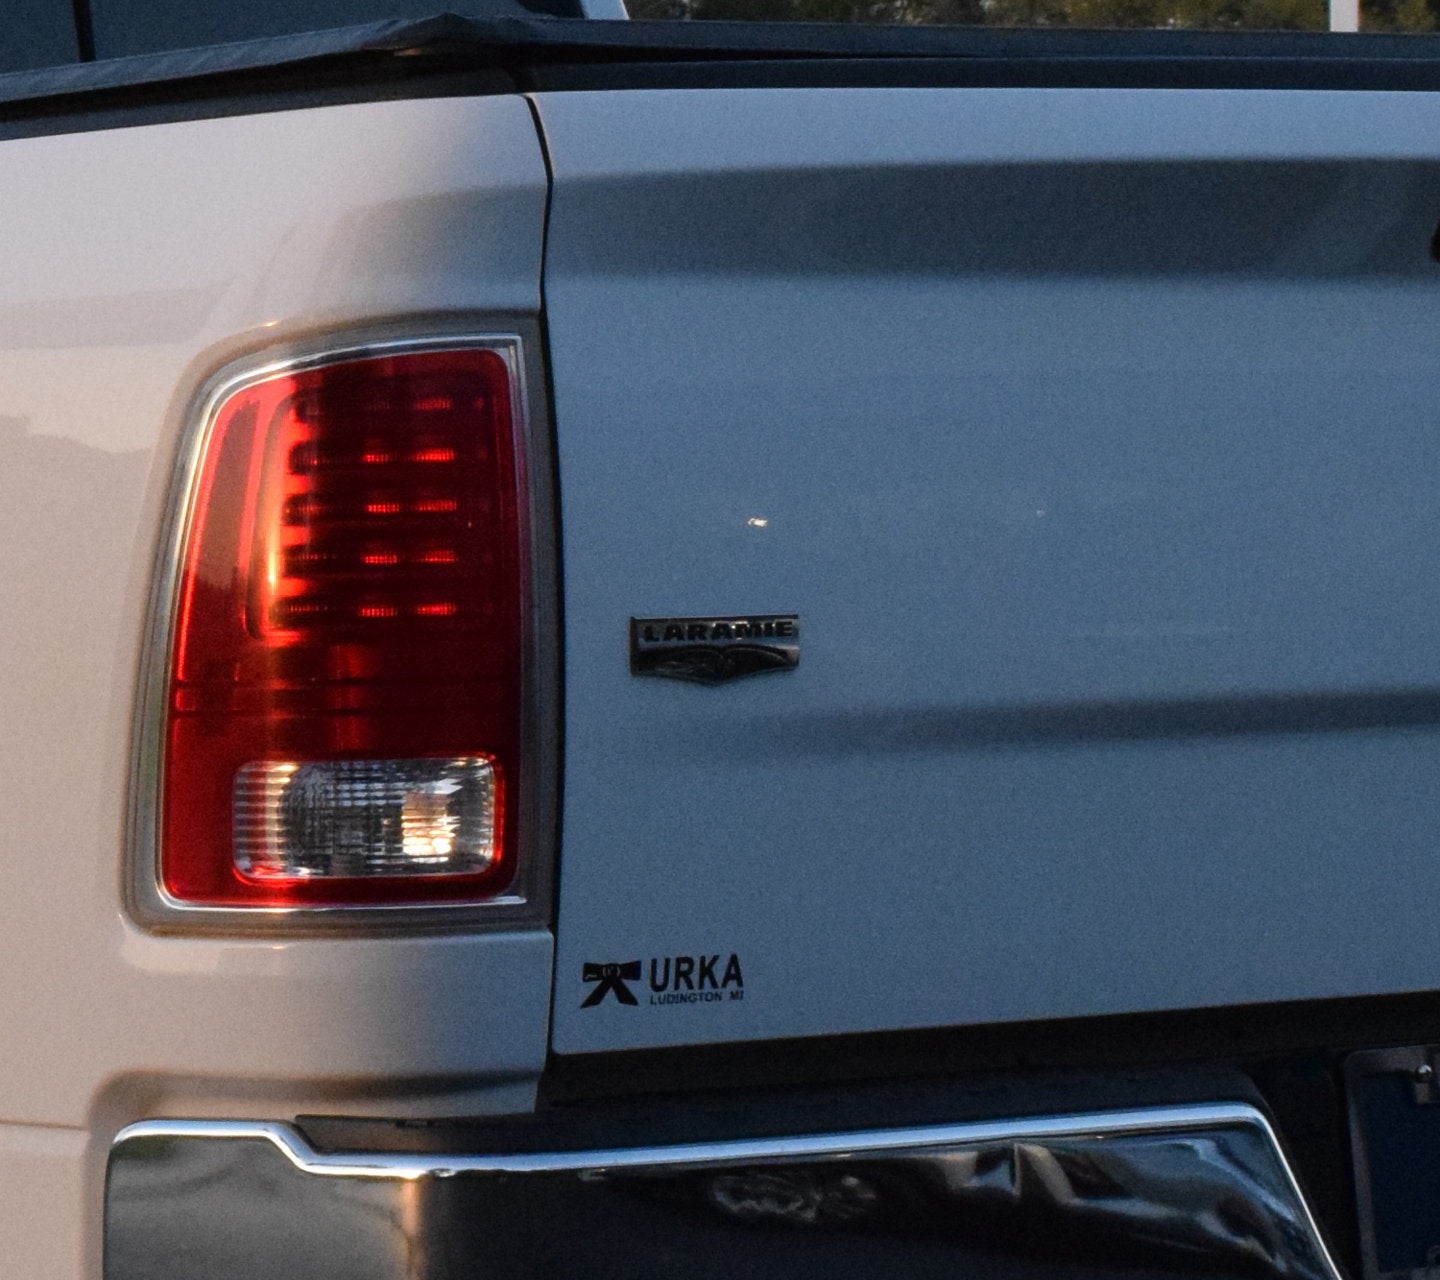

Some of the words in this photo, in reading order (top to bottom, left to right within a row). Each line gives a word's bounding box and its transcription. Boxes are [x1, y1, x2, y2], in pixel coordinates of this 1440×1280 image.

[642, 619, 794, 642] LARAMIE
[649, 953, 744, 992] URKA
[649, 991, 722, 1005] LUDINGTON
[729, 990, 744, 1001] MI
